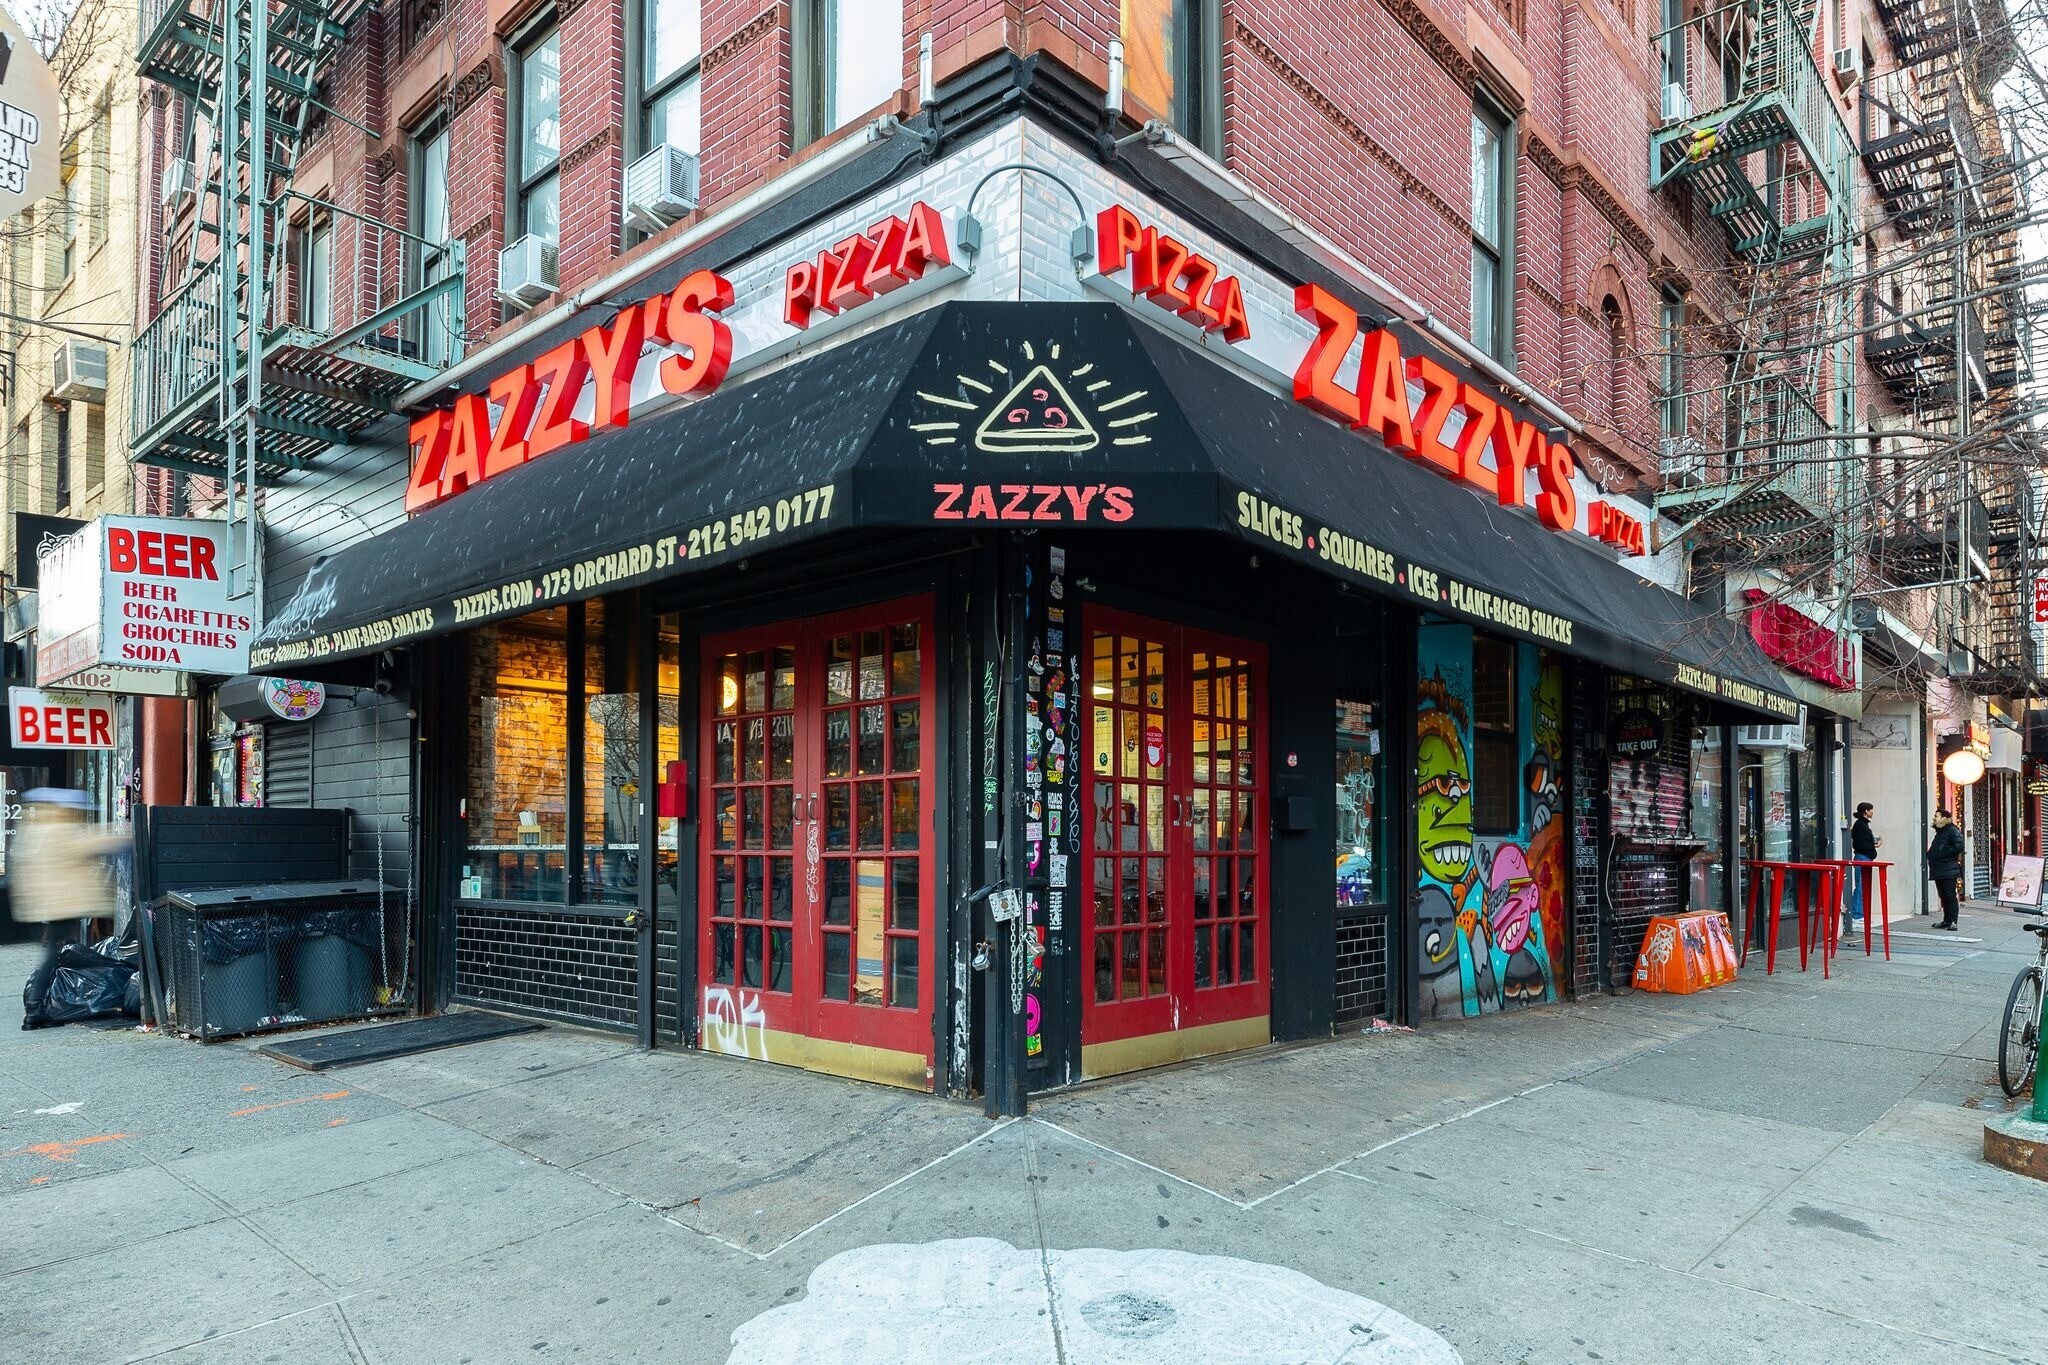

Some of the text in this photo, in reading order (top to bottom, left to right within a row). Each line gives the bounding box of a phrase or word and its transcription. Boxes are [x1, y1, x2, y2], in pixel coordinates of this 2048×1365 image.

[784, 200, 951, 330] PIZZA
[1097, 203, 1251, 344] PIZZA
[404, 269, 735, 513] ZAZZY'S
[1293, 281, 1576, 533] ZAZZY'S
[933, 483, 1134, 522] ZAZZY'S
[1588, 500, 1645, 557] PIZZA
[108, 527, 219, 581] BEER
[454, 484, 835, 623] ZAZZYS.COM 173 ORCHARD ST 212 542 0177
[1237, 491, 1573, 645] SLICES SQUARES ICES PLANT-BASED SNACKS
[123, 581, 177, 602] BEER
[122, 623, 237, 649] GROCERIES
[123, 602, 250, 632] CIGARETTES
[250, 645, 272, 669] SLICES
[312, 635, 331, 657] ICES
[333, 620, 392, 652] PLANT-BASED
[392, 608, 434, 638] SNACKS
[122, 643, 181, 664] SODA
[46, 695, 84, 705] SPECIAL
[1678, 663, 1717, 694] ZAZZYS.COM
[1721, 678, 1732, 698] 173
[1733, 682, 1758, 706] ORCHARD
[18, 706, 112, 745] BEER
[1616, 739, 1658, 753] TAKE OUT
